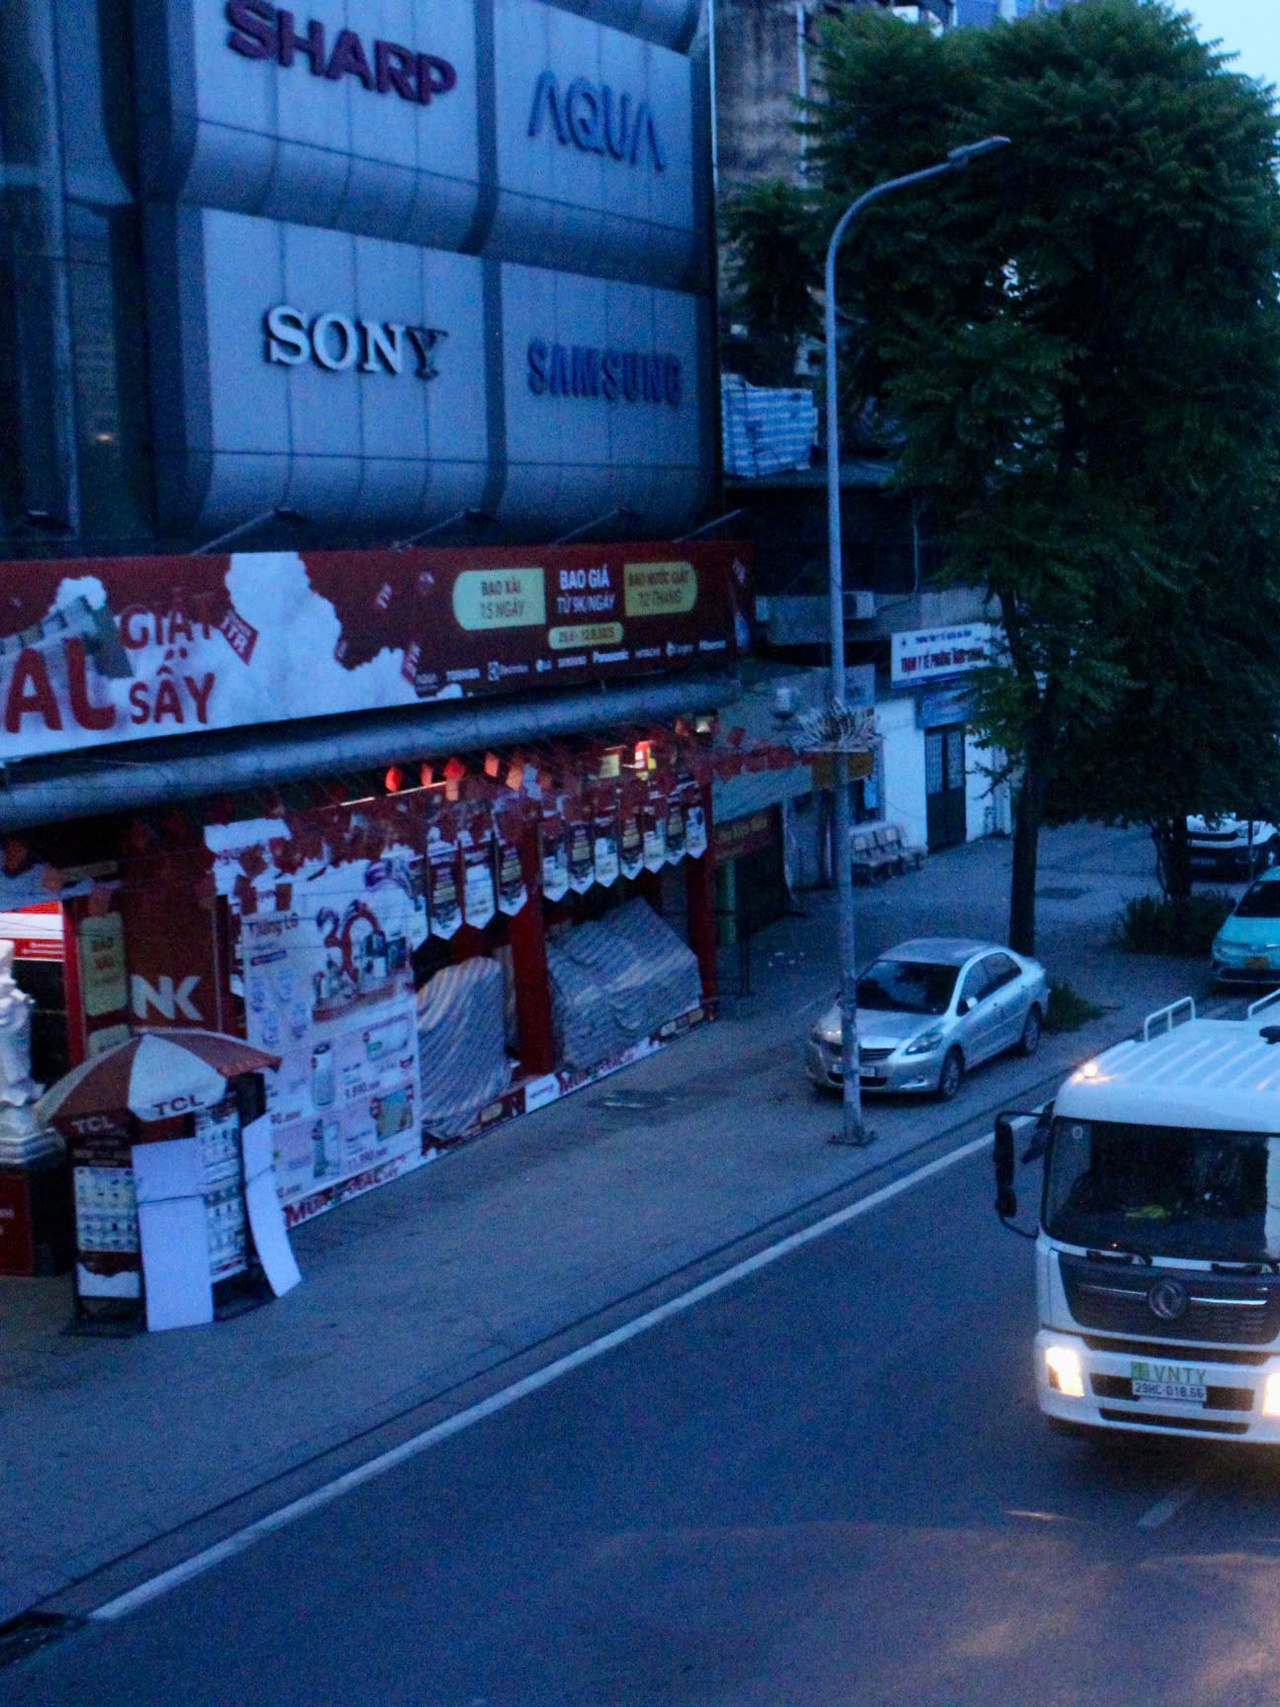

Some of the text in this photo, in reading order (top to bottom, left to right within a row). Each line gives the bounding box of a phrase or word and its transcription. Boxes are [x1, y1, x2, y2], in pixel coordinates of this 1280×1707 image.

[224, 0, 457, 105] SHARP
[527, 70, 665, 172] AQUA
[263, 305, 448, 381] SONY
[526, 337, 682, 405] SAMSUNG
[130, 973, 204, 1020] NK
[71, 1114, 115, 1136] TCL
[152, 1093, 205, 1116] TCL
[1153, 1364, 1207, 1384] VNTY
